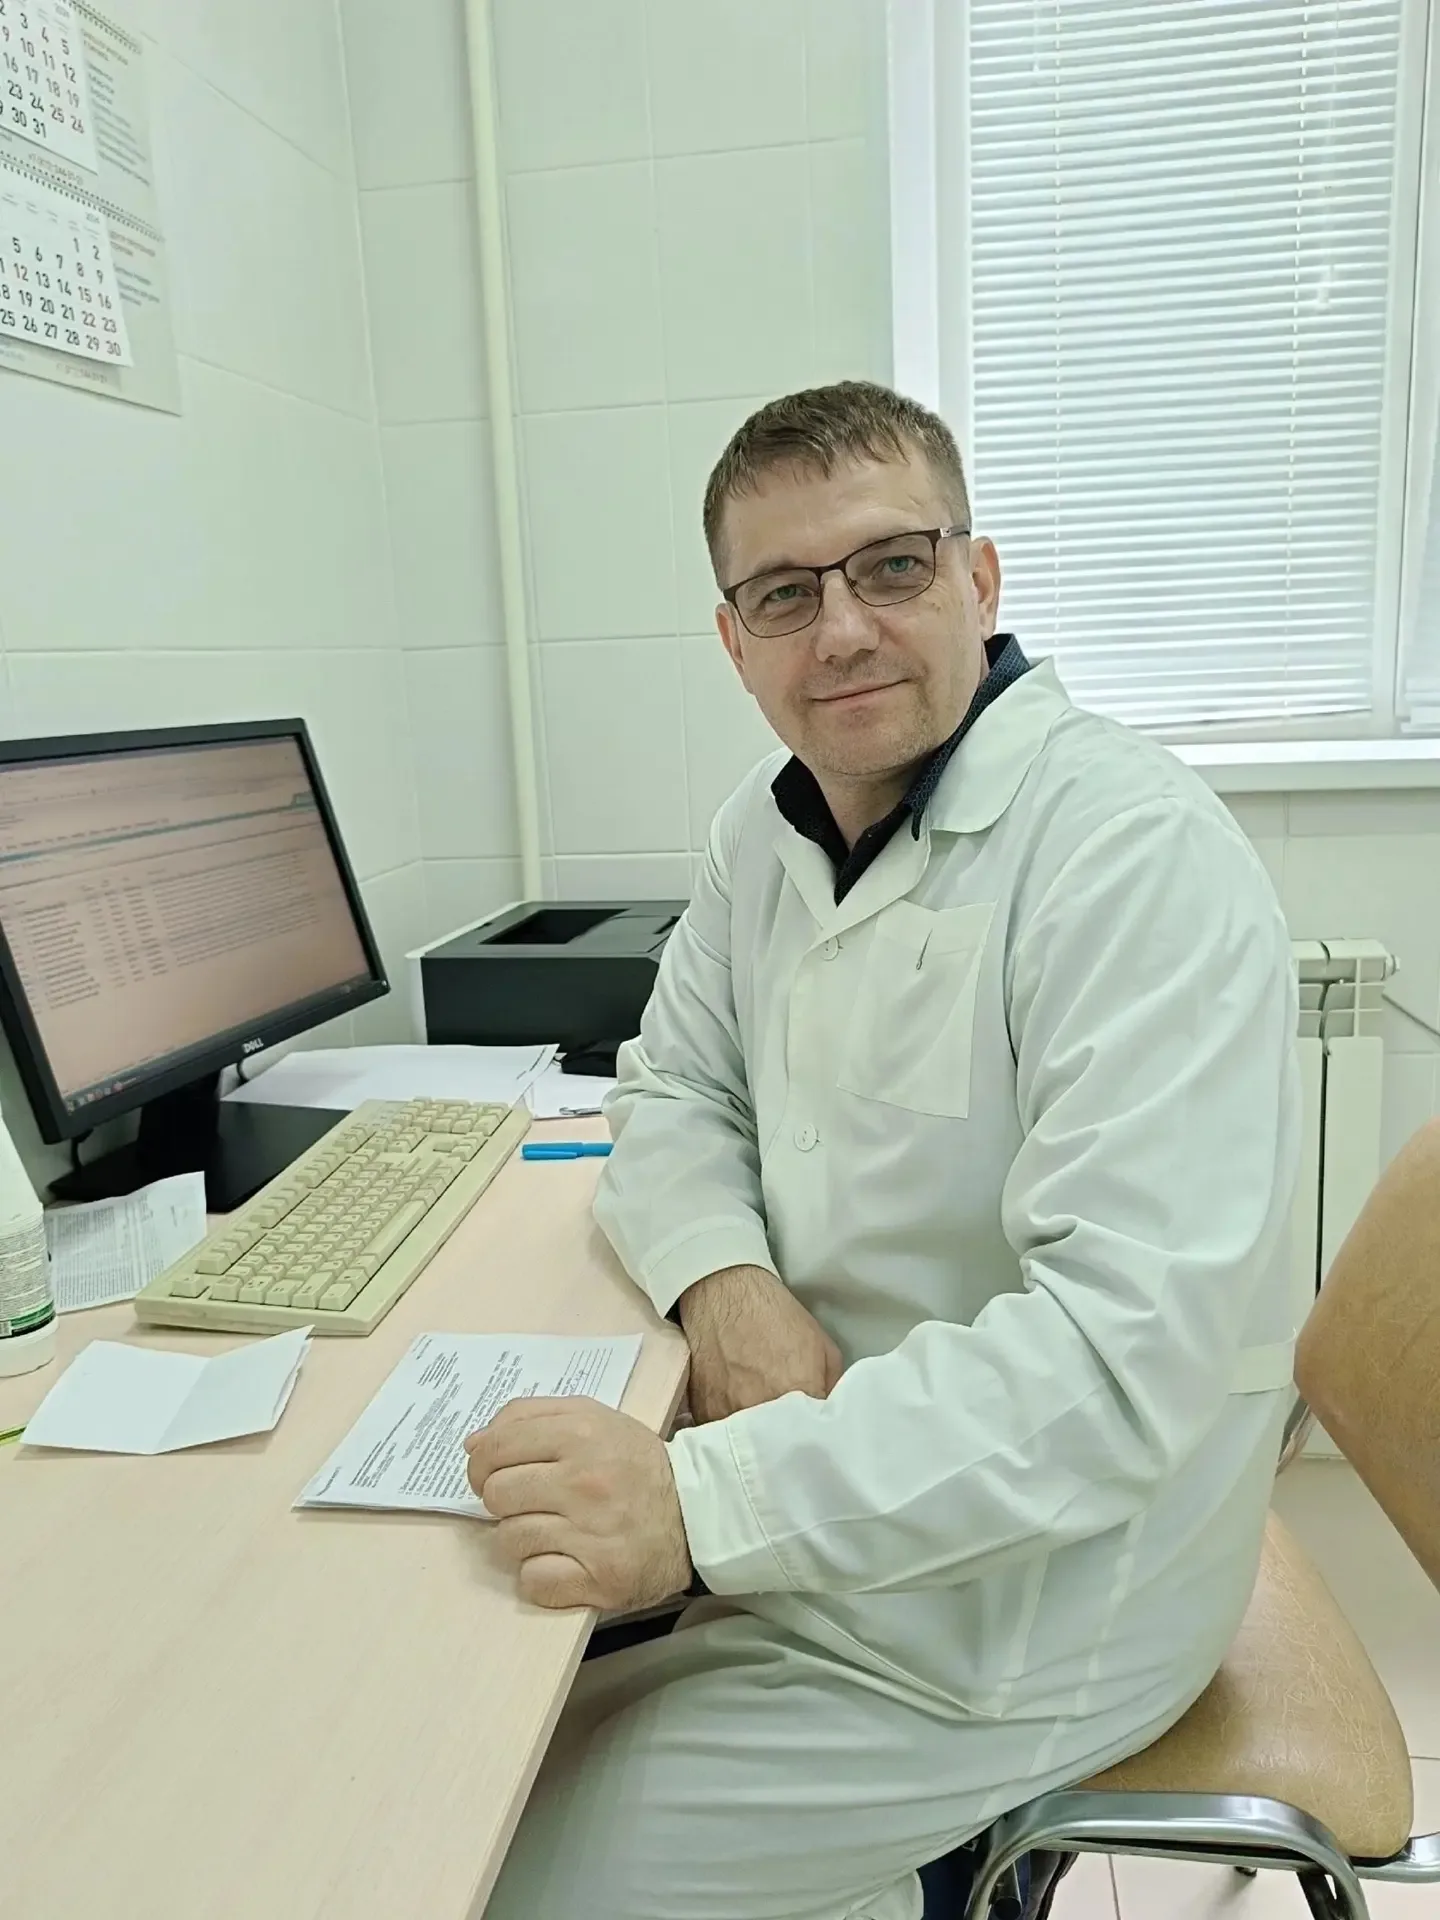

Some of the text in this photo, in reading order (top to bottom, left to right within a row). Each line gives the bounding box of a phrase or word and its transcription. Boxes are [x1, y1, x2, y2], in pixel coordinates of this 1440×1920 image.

[2, 25, 10, 42] 9
[20, 37, 35, 58] 10
[42, 50, 55, 71] 11
[62, 63, 77, 84] 12
[20, 12, 28, 29] 3
[41, 26, 49, 43] 4
[61, 38, 70, 56] 5
[3, 52, 80, 109] 16 17 18 19
[7, 79, 23, 100] 23
[29, 91, 45, 113] 24
[49, 103, 65, 123] 25
[11, 106, 27, 128] 30
[32, 117, 47, 138] 31
[12, 236, 22, 254] 5
[35, 246, 43, 262] 6
[55, 253, 63, 269] 7
[76, 261, 85, 278] 8
[96, 269, 104, 284] 9
[73, 237, 80, 253] 1
[92, 244, 101, 261] 2
[13, 262, 29, 282] 12
[35, 270, 51, 289] 13
[57, 278, 72, 297] 14
[78, 285, 93, 304] 15
[98, 292, 112, 310] 16
[0, 308, 122, 357] 25 26 27 28 29 30
[18, 289, 33, 308] 19
[39, 296, 55, 315] 20
[60, 303, 75, 321] 21
[81, 310, 97, 328] 22
[101, 316, 117, 334] 23
[242, 1037, 264, 1053] DELL
